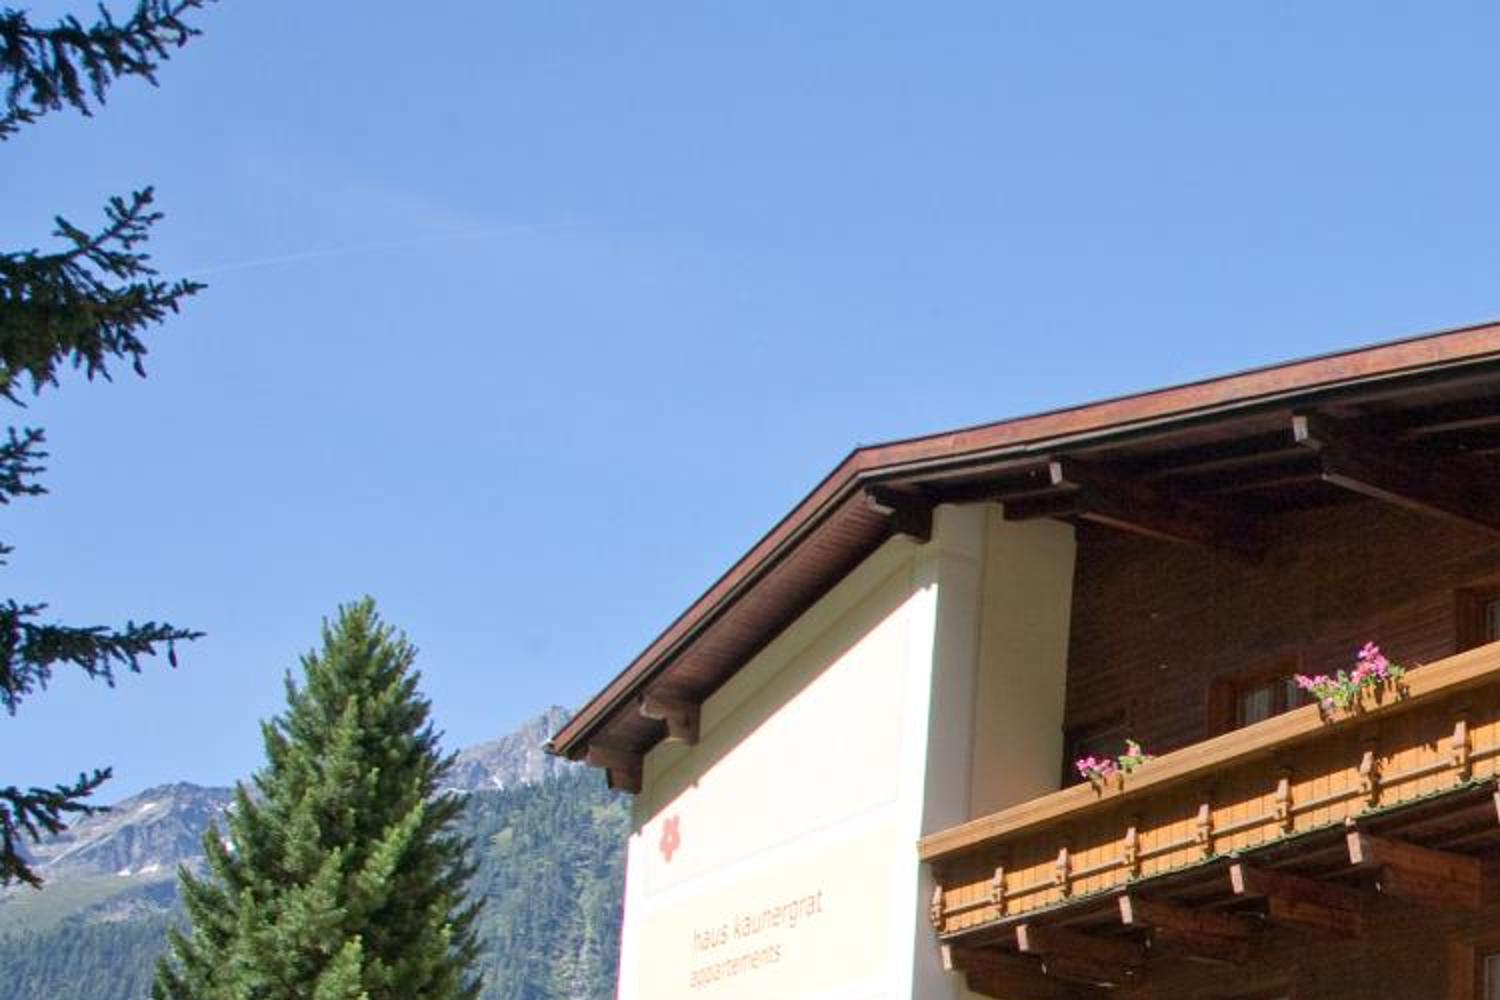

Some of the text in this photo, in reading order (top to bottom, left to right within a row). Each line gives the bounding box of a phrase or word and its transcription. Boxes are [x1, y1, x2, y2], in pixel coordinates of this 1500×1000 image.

[693, 889, 823, 951] haus kaunergrat
[689, 944, 781, 990] appartements
